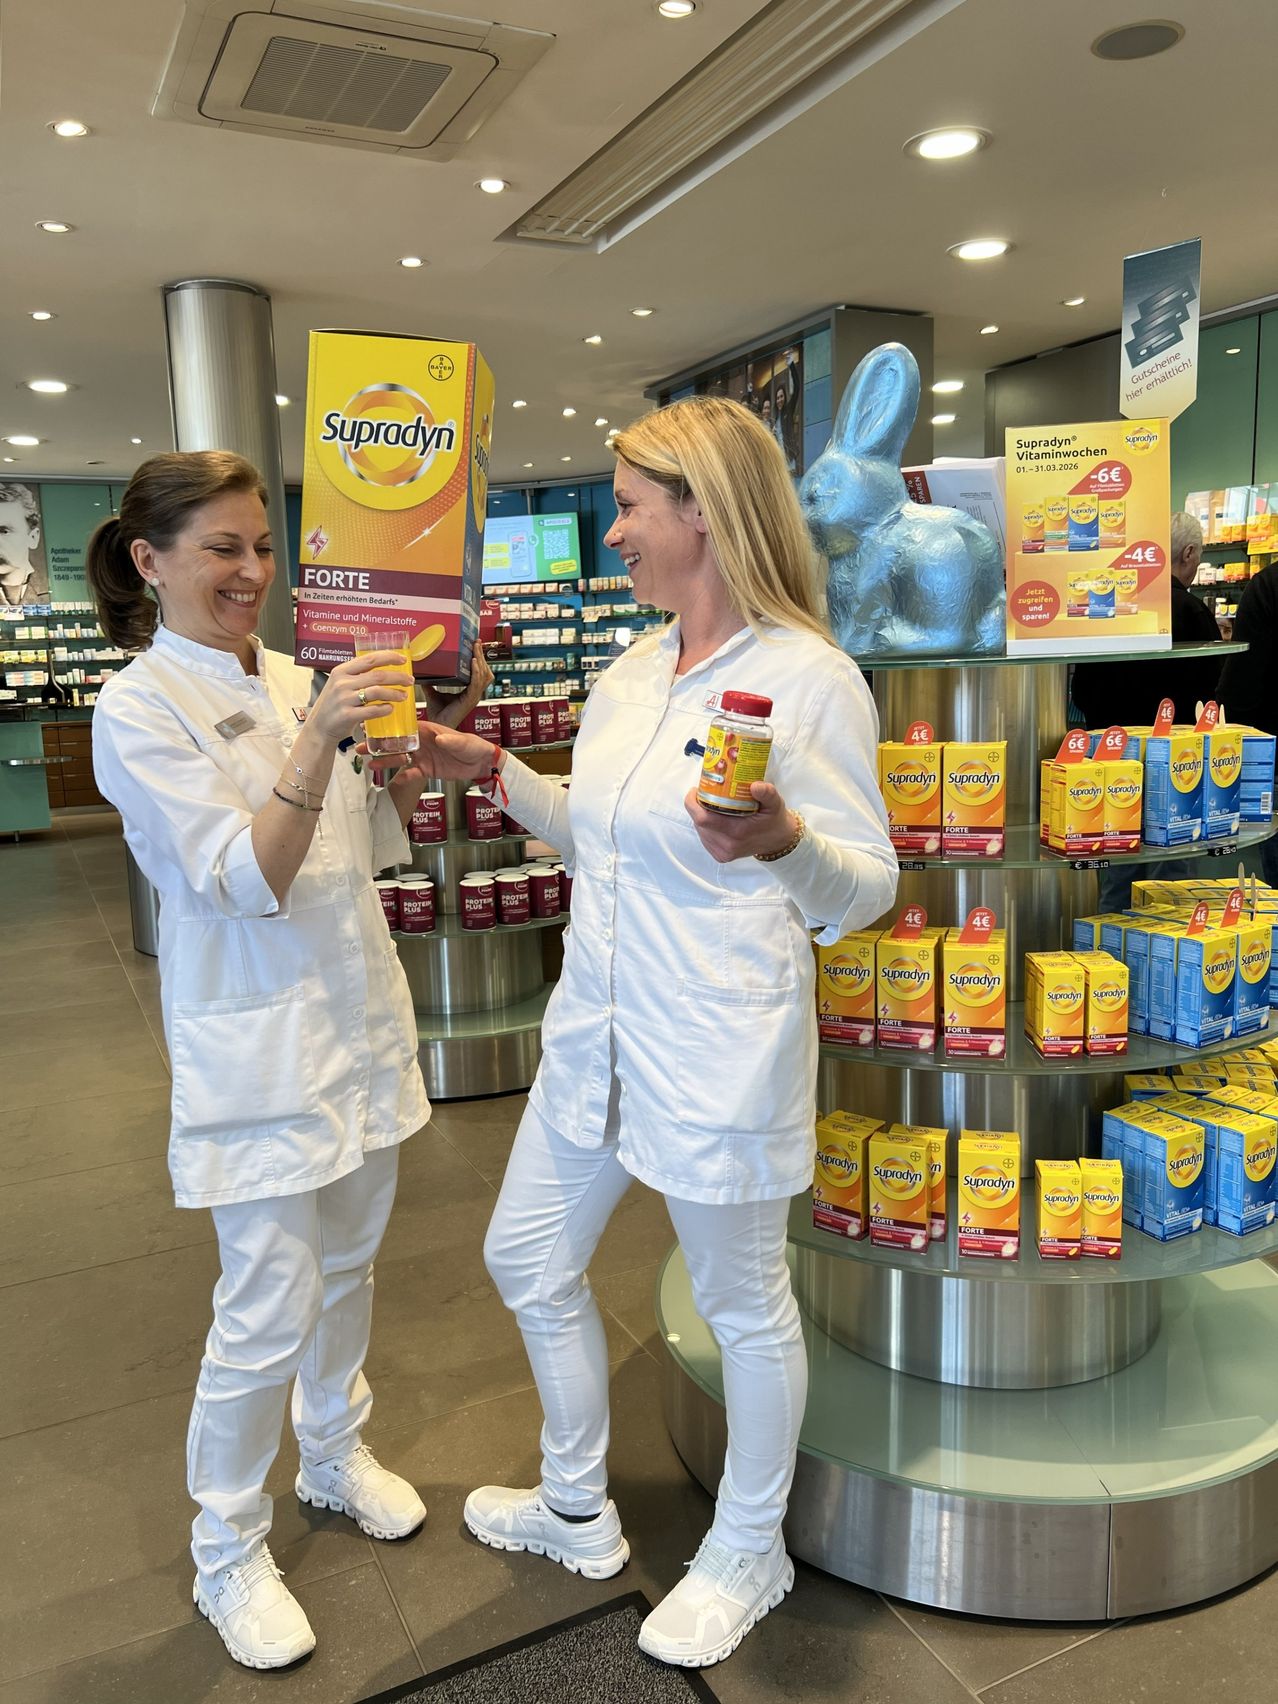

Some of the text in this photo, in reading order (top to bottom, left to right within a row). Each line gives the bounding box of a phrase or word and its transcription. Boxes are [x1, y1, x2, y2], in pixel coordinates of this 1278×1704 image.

[1131, 353, 1181, 384] Gutscheine
[1126, 358, 1192, 401] hier erhältlich!
[1125, 434, 1158, 446] Supradyn
[1016, 447, 1107, 460] Vitaminwochen
[304, 568, 370, 589] FORTE
[312, 593, 334, 601] Zeiten
[336, 595, 367, 603] erhöhten
[303, 609, 340, 620] Vitamine
[361, 614, 417, 626] Mineralstoffe
[1022, 613, 1049, 621] sparen!
[312, 623, 347, 633] Coenzym
[301, 647, 317, 659] 60
[1161, 707, 1172, 718] 4€
[1205, 709, 1216, 721] 4€
[912, 730, 928, 741] 4€
[1106, 735, 1122, 746] 6€
[1068, 738, 1085, 749] 6€
[1172, 759, 1201, 773] Supradyn
[1212, 755, 1240, 769] Supradyn
[887, 772, 936, 785] Supradyn
[948, 772, 1000, 786] Supradyn
[1069, 787, 1101, 798] Supradyn
[1107, 784, 1140, 794] Supradyn
[1230, 898, 1240, 908] 4€
[905, 913, 922, 924] 4€
[972, 916, 990, 927] 4€
[1195, 911, 1205, 921] 4€
[1241, 949, 1269, 966] Supradyn
[823, 964, 870, 978] Supradyn
[1205, 959, 1235, 976] Supradyn
[882, 967, 930, 982] Supradyn
[949, 974, 1000, 987] Supradyn
[1047, 991, 1081, 1000] Supradyn
[1093, 989, 1125, 998] Supradyn
[817, 1151, 858, 1171] Supradyn
[1246, 1147, 1276, 1164] Supradyn
[1169, 1153, 1202, 1171] Supradyn
[874, 1166, 922, 1183] Supradyn
[964, 1176, 1014, 1190] Supradyn
[1044, 1194, 1079, 1202] Supradyn
[1084, 1192, 1119, 1202] Supradyn
[815, 1201, 833, 1210] FORTE
